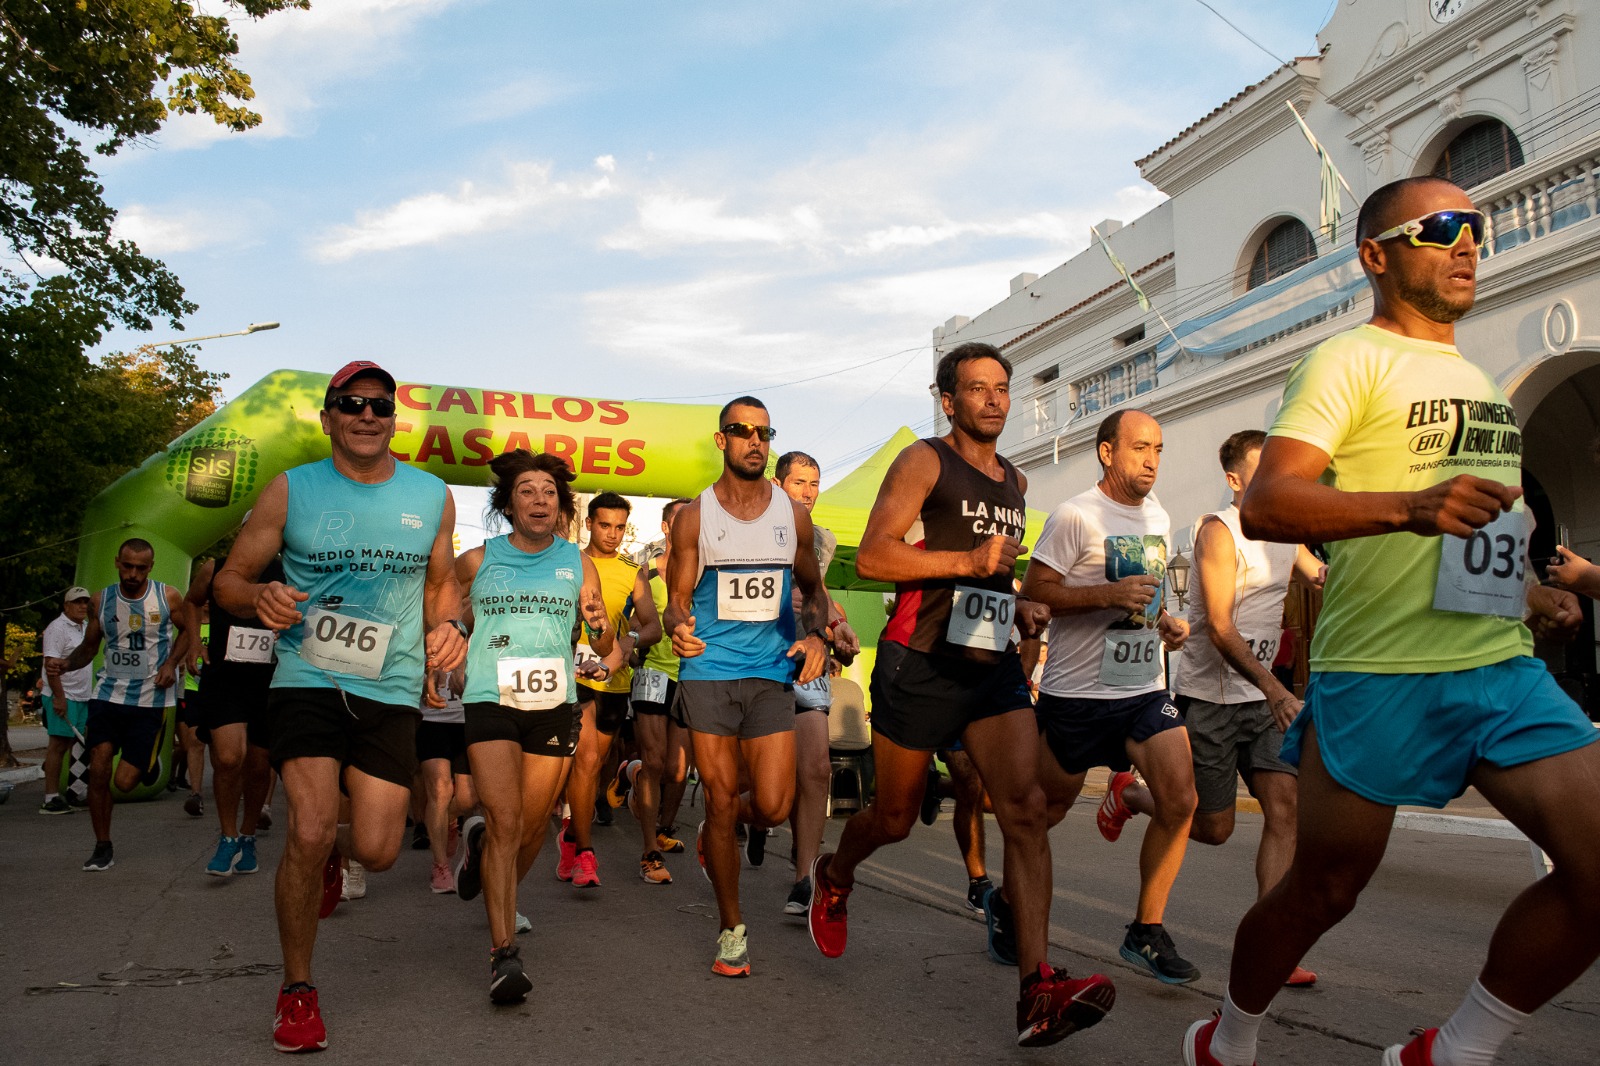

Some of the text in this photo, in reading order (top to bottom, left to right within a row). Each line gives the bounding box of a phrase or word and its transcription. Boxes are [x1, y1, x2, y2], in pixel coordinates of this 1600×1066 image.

[397, 384, 630, 425] CARLOS
[191, 453, 231, 477] sis
[1409, 458, 1476, 474] TRANSFORMANDO
[1476, 458, 1502, 467] ENERGÍA
[190, 486, 226, 496] inclusivo
[962, 500, 989, 519] LA
[401, 518, 423, 530] mgp
[308, 549, 355, 562] MEDIO
[314, 564, 344, 574] MAR
[350, 562, 377, 572] DEL
[729, 577, 775, 599] 168
[480, 595, 573, 608] MEDIO MARATON
[965, 593, 1009, 625] 050
[483, 608, 505, 616] MAR
[126, 632, 146, 651] 10
[235, 634, 270, 651] 178
[316, 616, 378, 652] 046
[112, 652, 140, 666] 058
[1114, 640, 1154, 664] 016
[512, 669, 558, 693] 163
